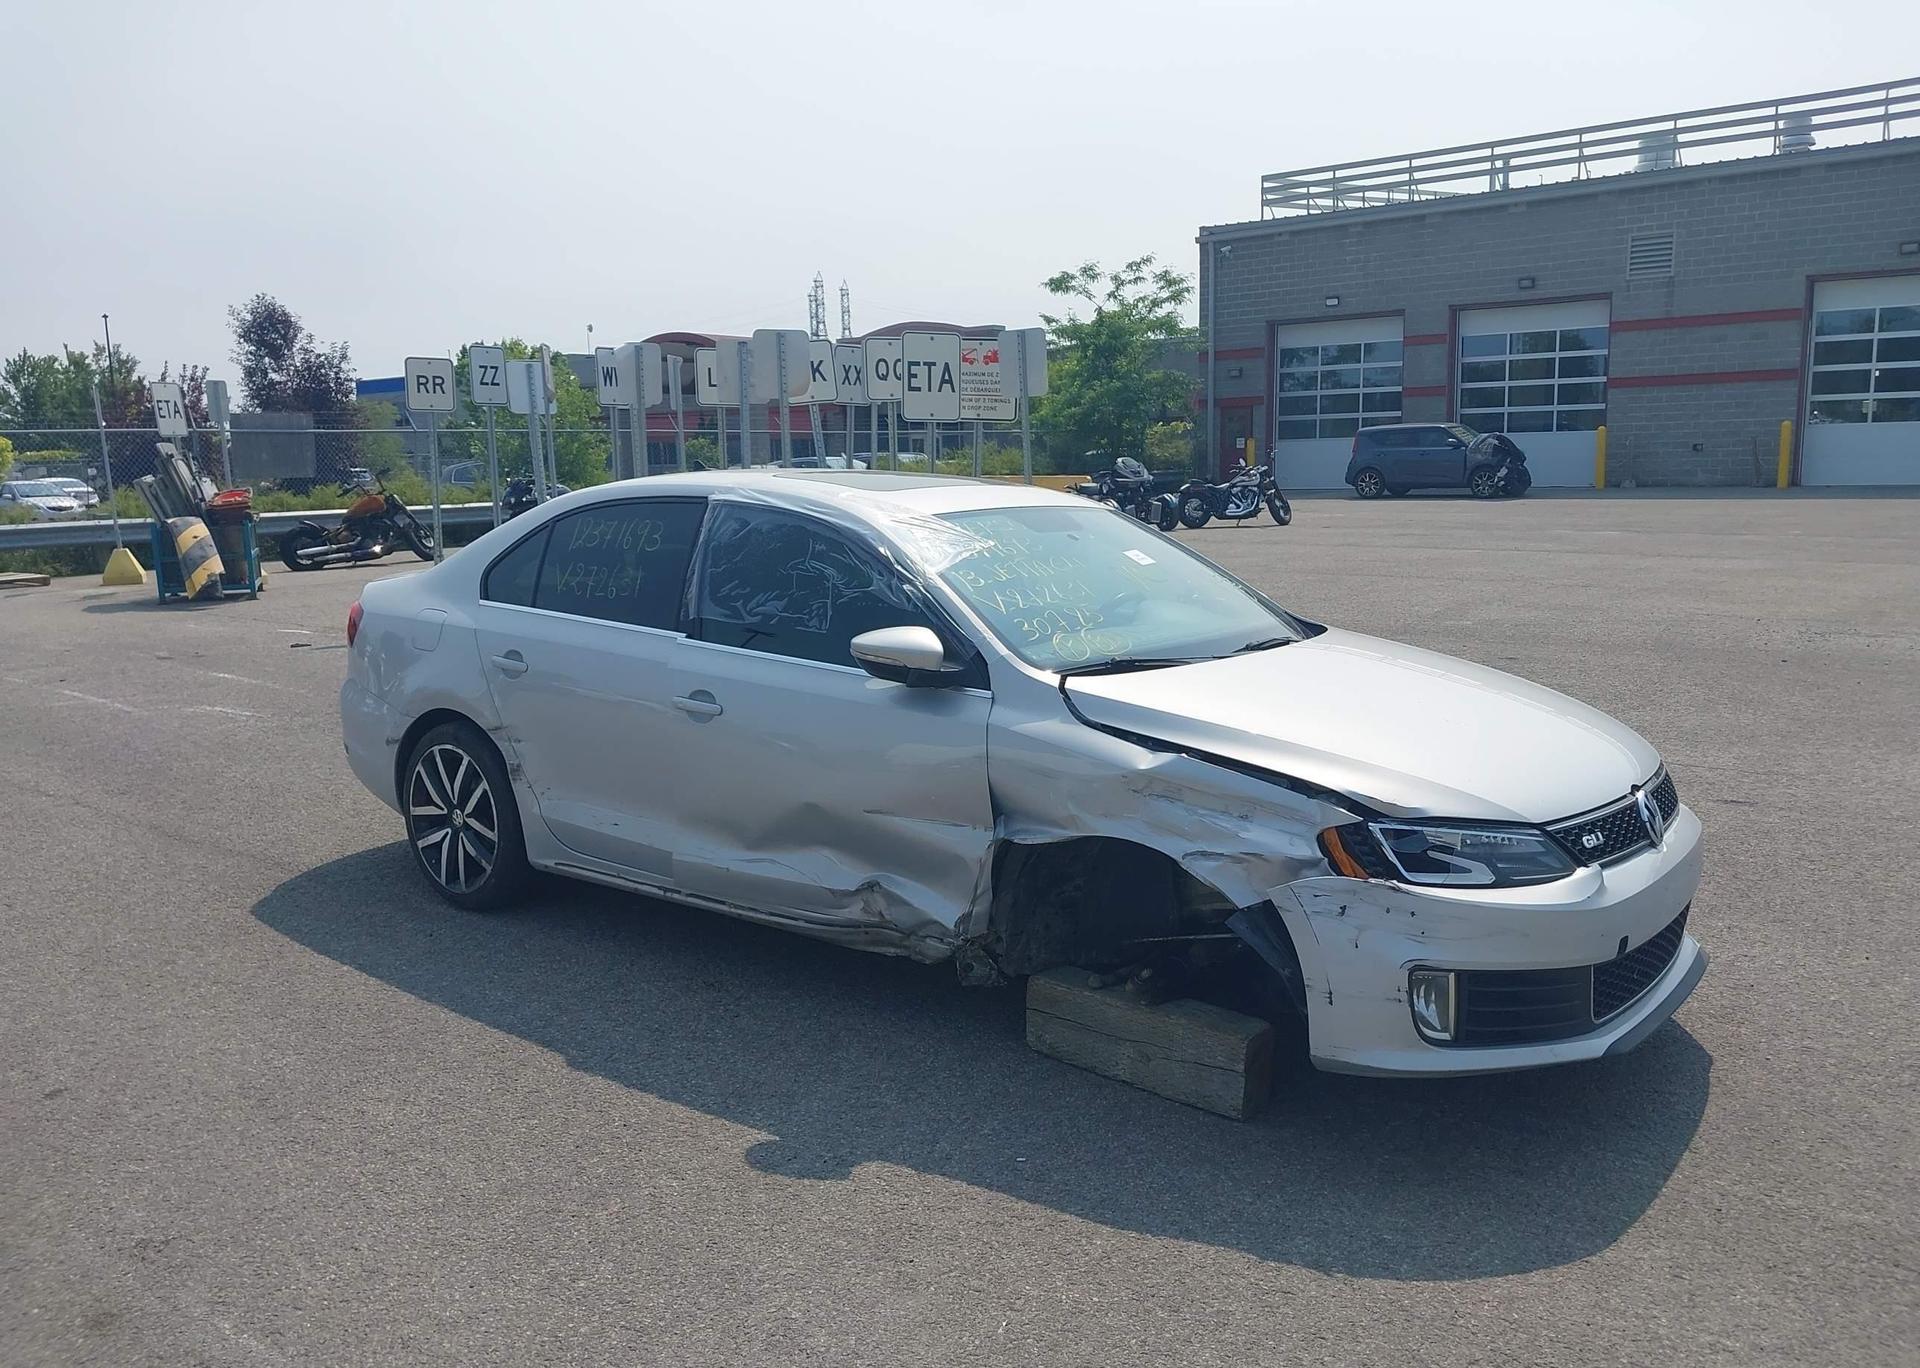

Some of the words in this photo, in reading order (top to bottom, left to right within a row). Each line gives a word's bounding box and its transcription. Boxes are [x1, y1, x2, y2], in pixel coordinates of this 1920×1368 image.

[478, 365, 500, 386] ZZ
[810, 360, 828, 382] K
[841, 364, 862, 386] XX
[907, 361, 956, 393] ETA
[417, 375, 445, 395] RR
[156, 399, 183, 420] ETA
[1582, 831, 1604, 849] GLI
